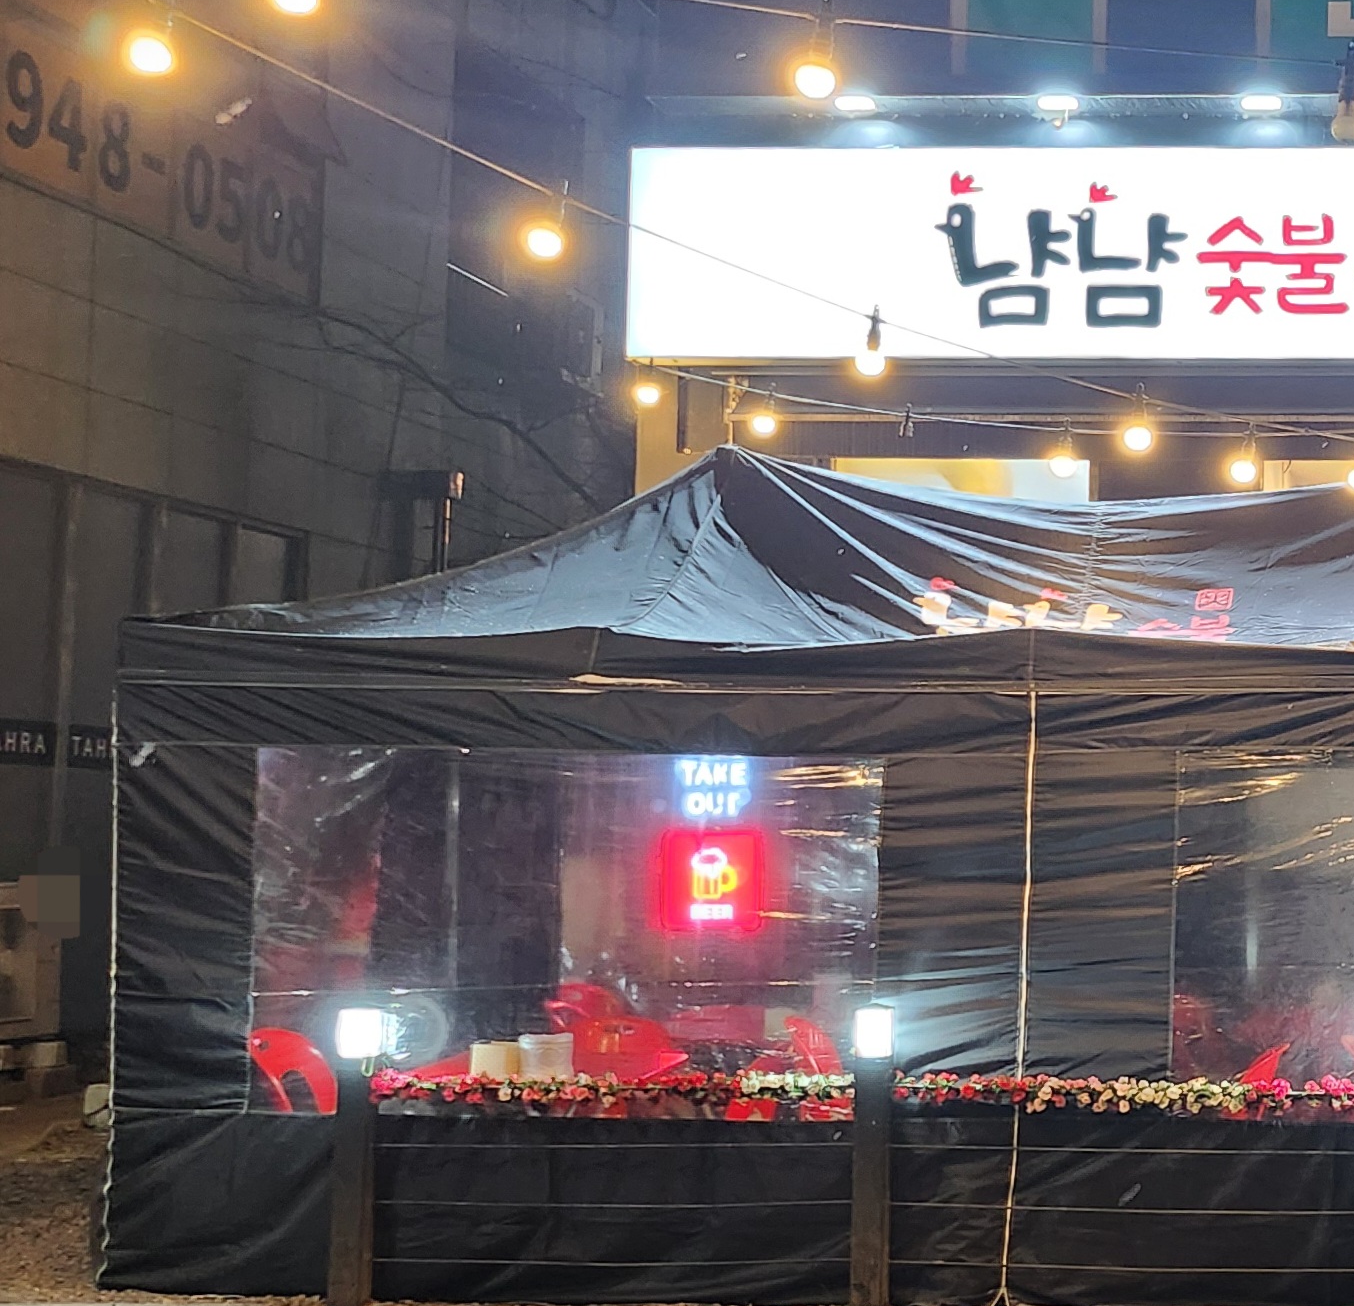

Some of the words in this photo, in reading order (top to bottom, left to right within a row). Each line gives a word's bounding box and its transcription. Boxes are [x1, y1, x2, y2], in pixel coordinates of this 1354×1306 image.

[0, 730, 46, 755] HRA
[680, 760, 747, 787] TAKE
[687, 792, 741, 816] OUT
